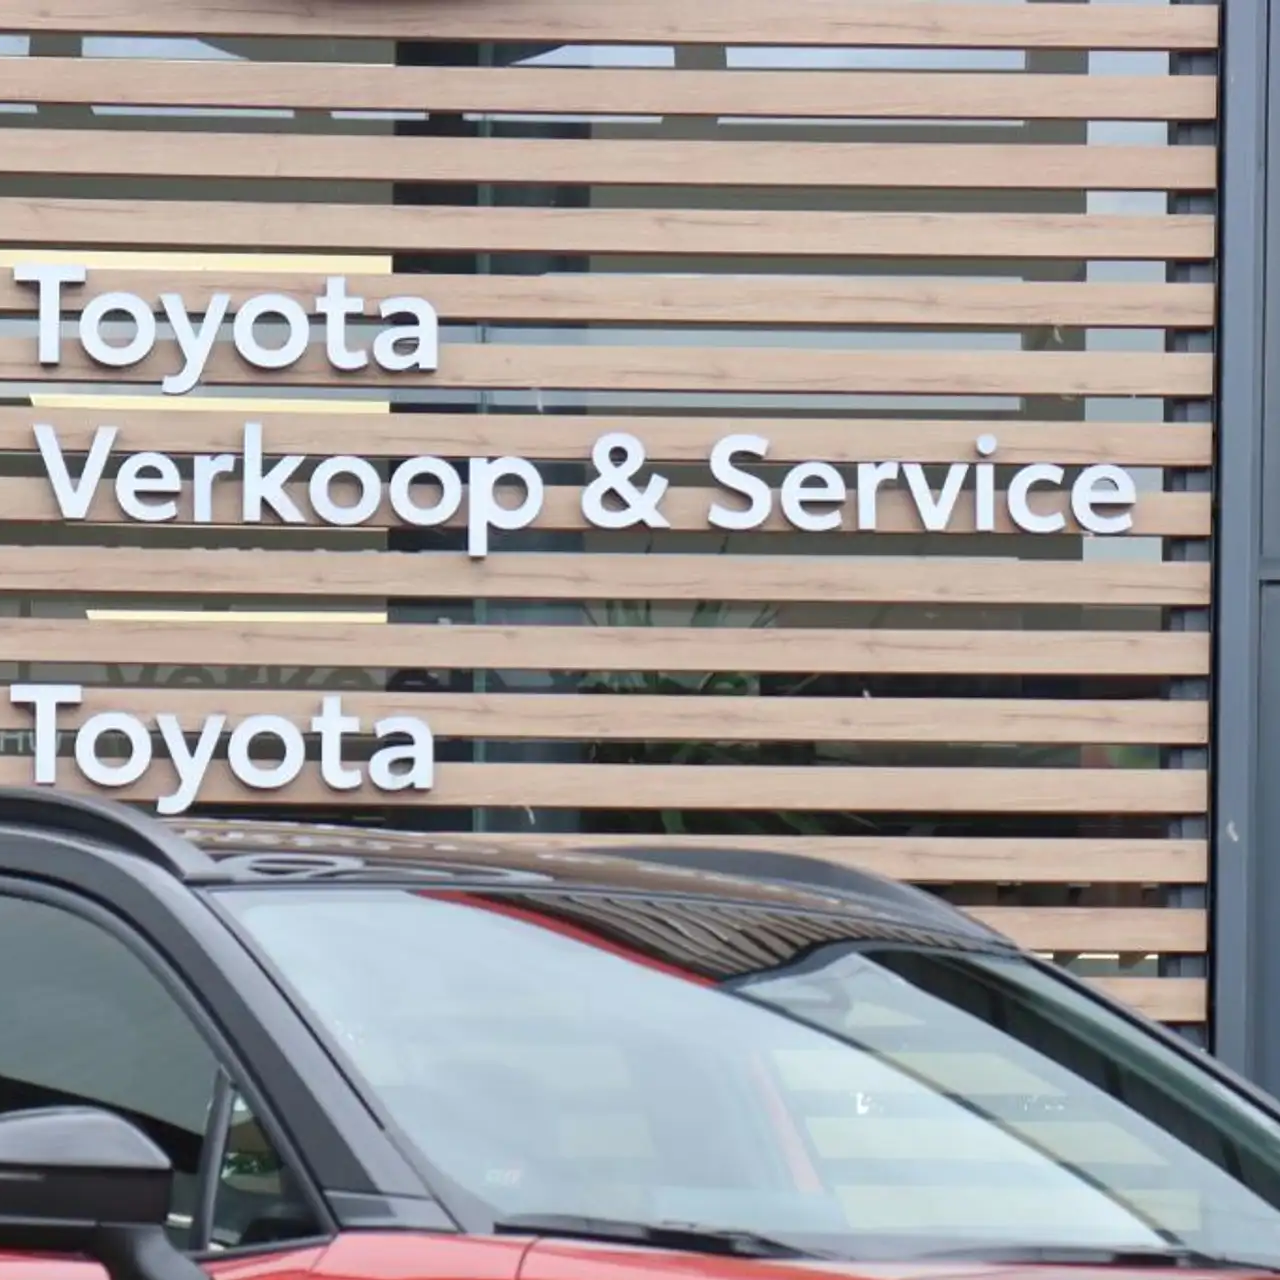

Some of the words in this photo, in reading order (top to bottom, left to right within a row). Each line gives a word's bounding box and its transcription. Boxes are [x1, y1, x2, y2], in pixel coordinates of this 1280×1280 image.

[14, 264, 439, 395] Toyota
[33, 422, 544, 558] Verkoop
[581, 432, 671, 529] &
[706, 434, 1137, 535] Service
[10, 683, 435, 815] Toyota
